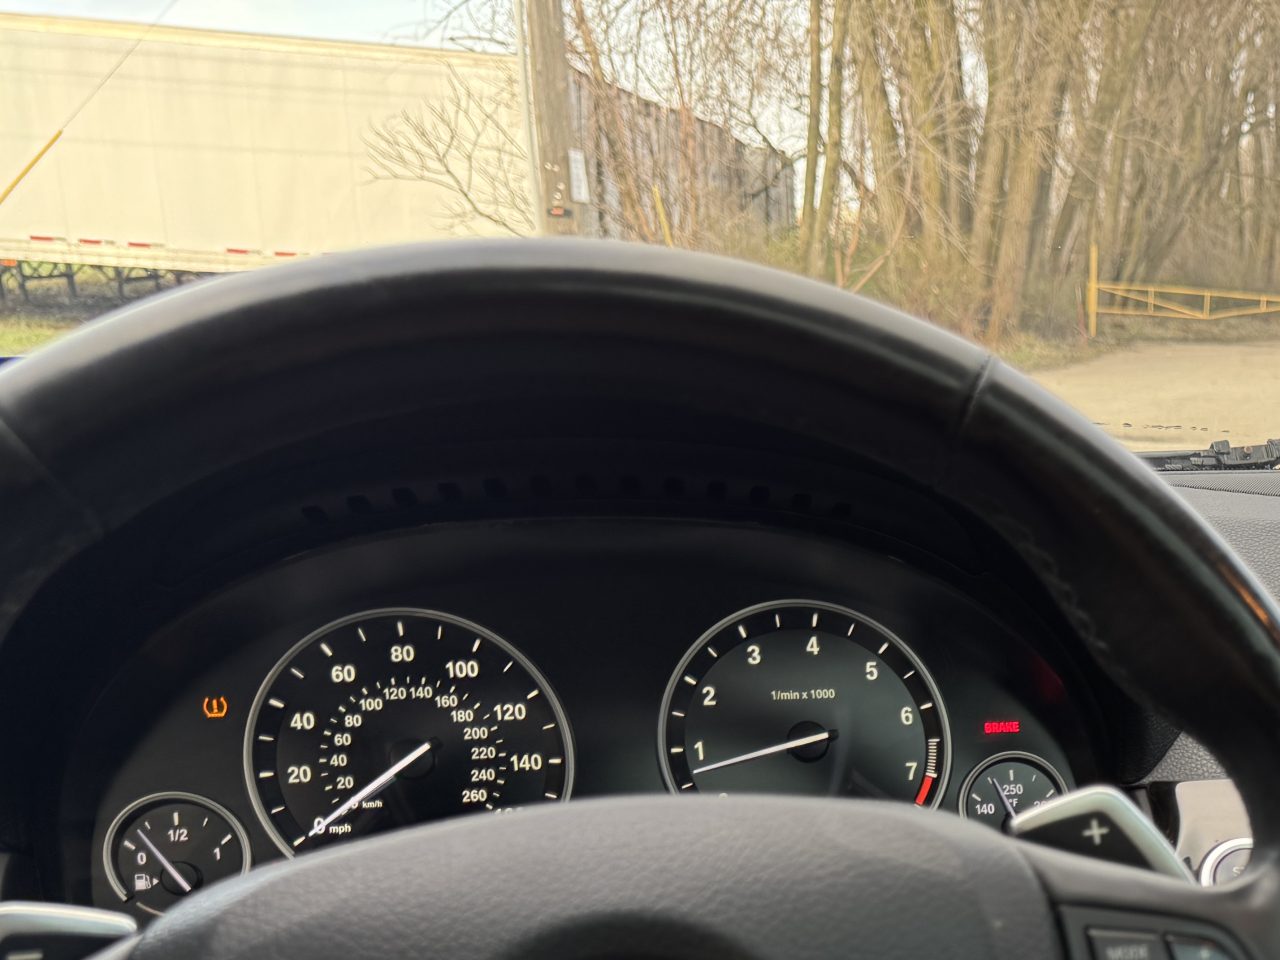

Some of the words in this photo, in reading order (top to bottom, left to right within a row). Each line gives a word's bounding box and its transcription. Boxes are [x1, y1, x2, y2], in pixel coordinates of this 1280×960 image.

[806, 636, 820, 655] 4
[390, 645, 415, 662] 80
[747, 645, 761, 664] 3
[331, 665, 355, 682] 60
[445, 661, 479, 678] 100
[865, 661, 878, 680] 5
[383, 687, 406, 700] 120
[409, 686, 433, 699] 140
[702, 686, 717, 706] 2
[771, 690, 799, 701] 1/min
[811, 689, 835, 699] 1000
[359, 698, 383, 711] 100
[434, 695, 458, 708] 160
[450, 710, 474, 722] 180
[493, 703, 526, 721] 120
[901, 707, 913, 725] 6
[290, 712, 315, 730] 40
[344, 715, 362, 727] 80
[984, 721, 1020, 734] BRAKE
[334, 733, 351, 746] 60
[463, 727, 488, 740] 200
[471, 747, 496, 760] 220
[694, 741, 704, 761] 1
[330, 754, 347, 766] 40
[510, 754, 542, 771] 140
[287, 766, 311, 783] 20
[471, 769, 495, 782] 240
[905, 762, 918, 780] 7
[336, 776, 354, 789] 20
[462, 789, 487, 803] 260
[1003, 784, 1023, 795] 250
[976, 804, 995, 814] 140
[167, 828, 188, 842] 1/2
[329, 824, 351, 835] mph
[137, 853, 146, 865] 0
[213, 847, 220, 861] 1
